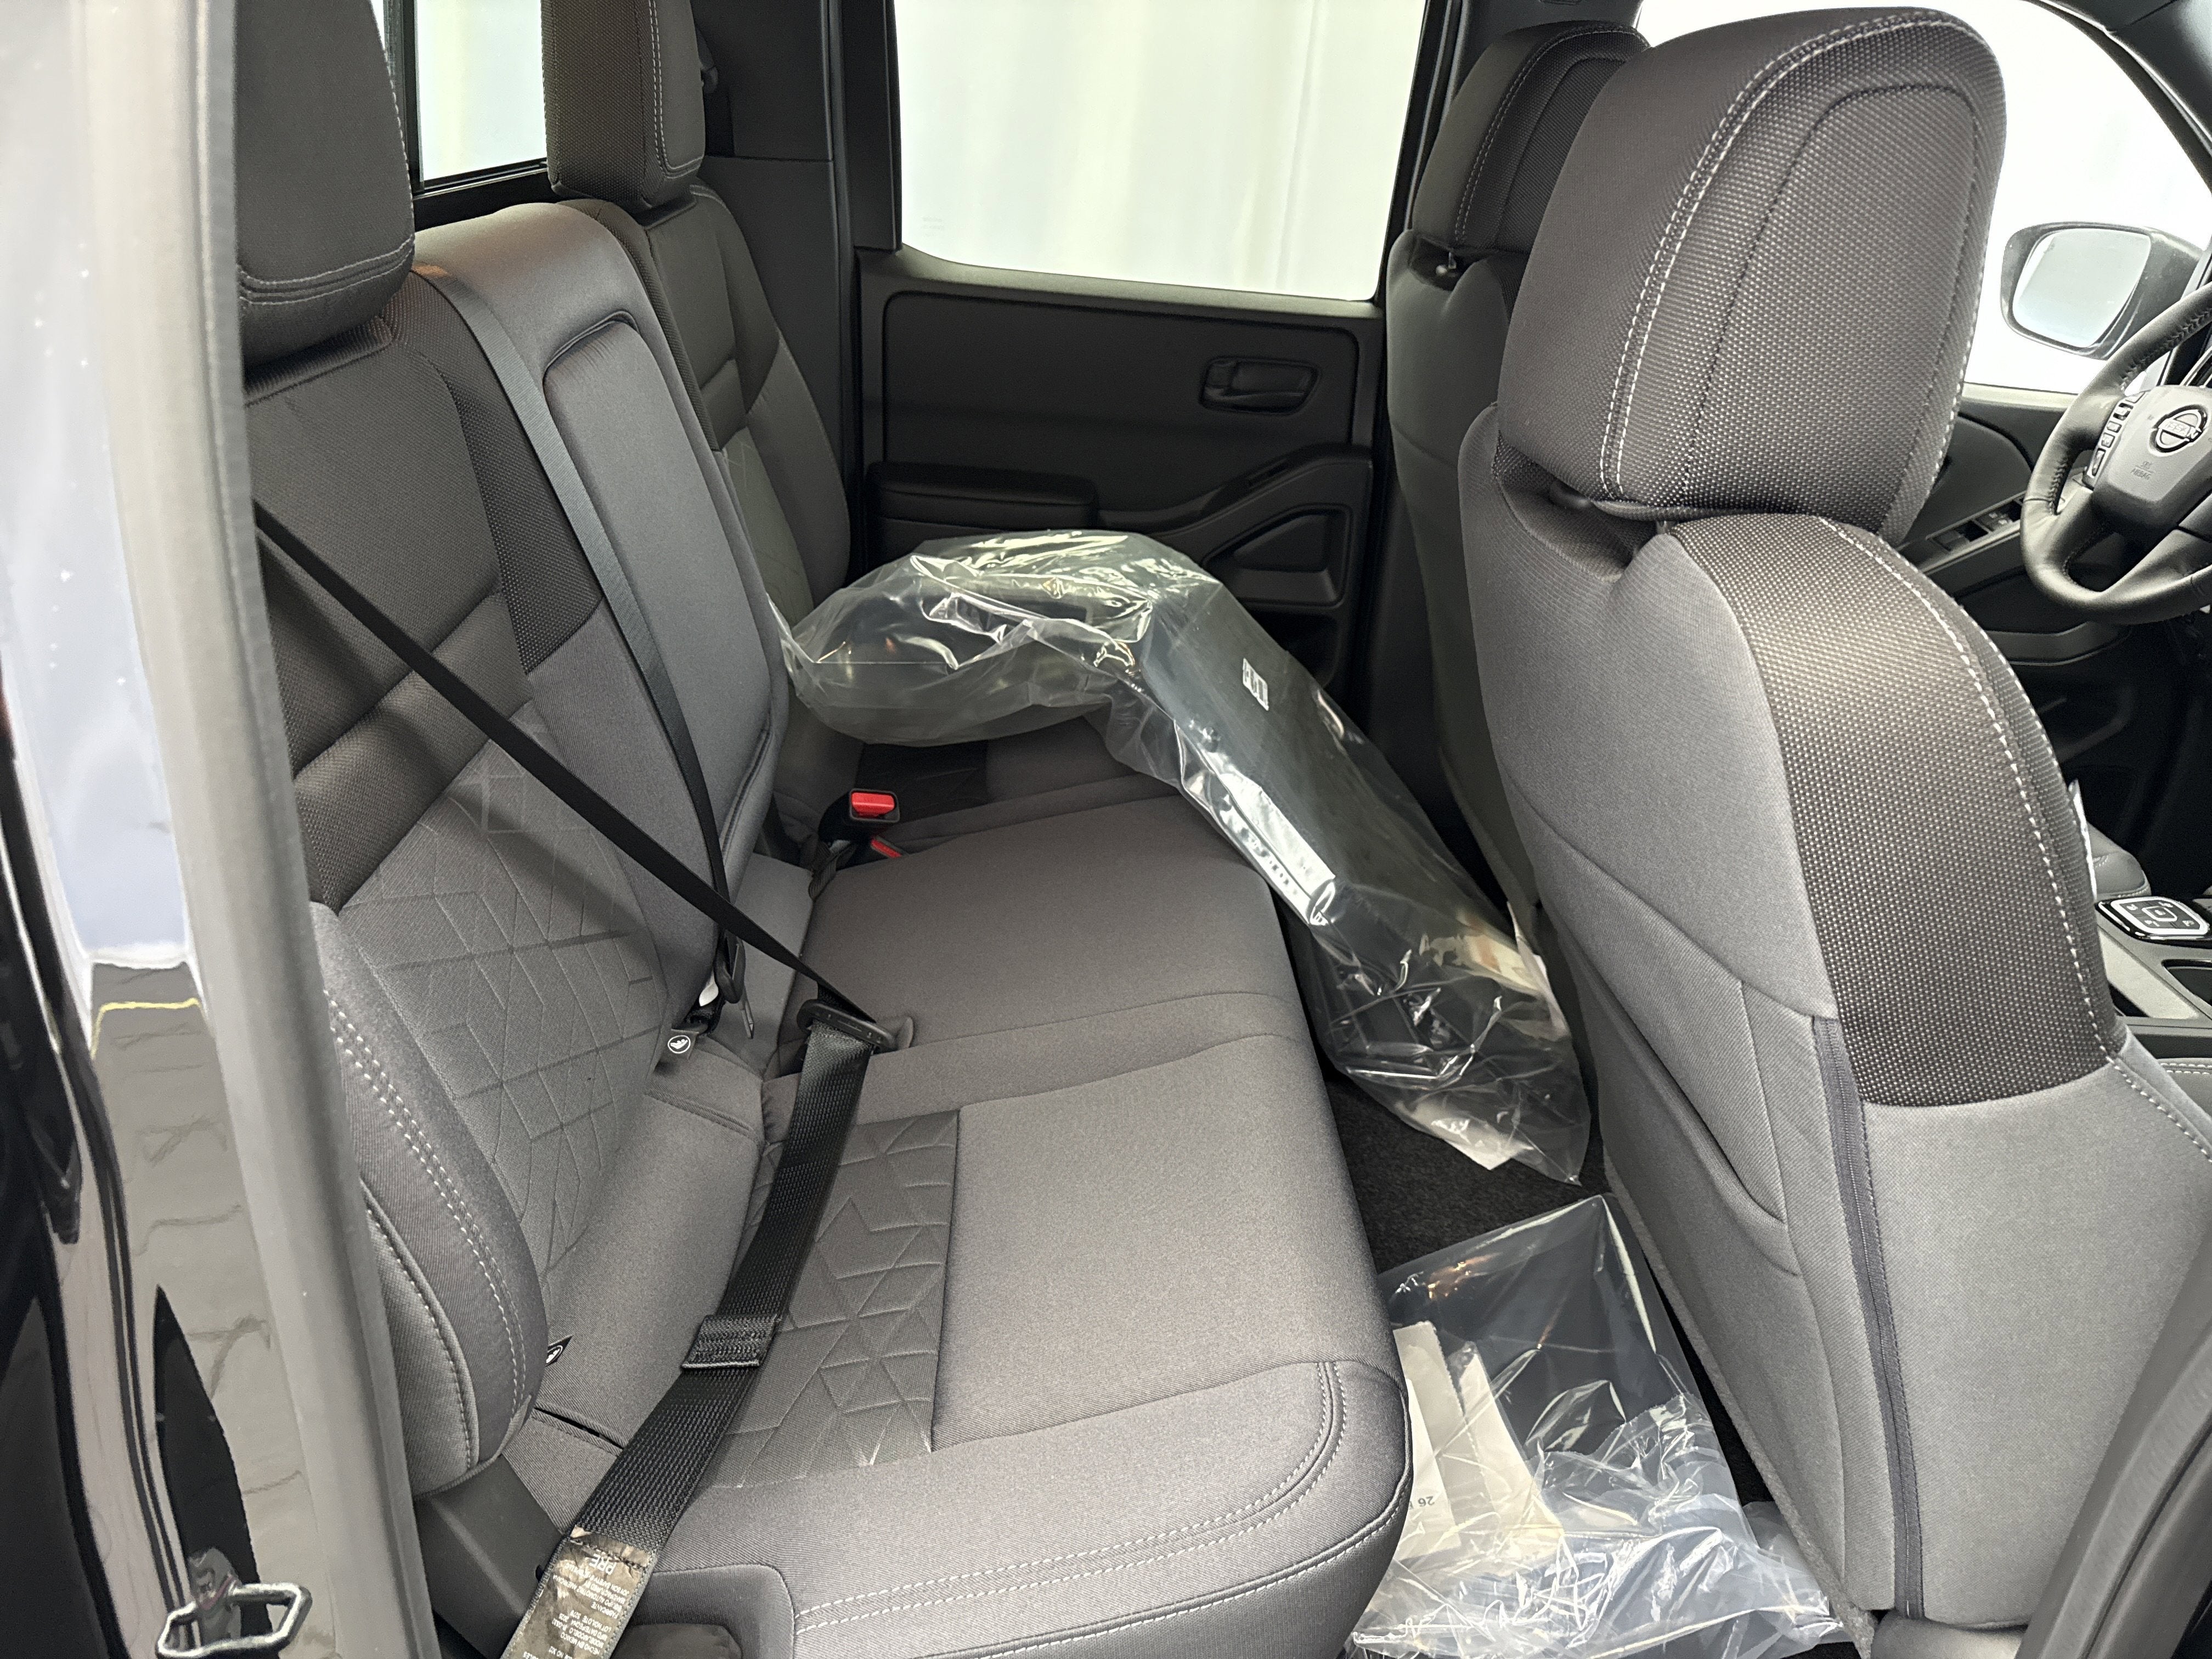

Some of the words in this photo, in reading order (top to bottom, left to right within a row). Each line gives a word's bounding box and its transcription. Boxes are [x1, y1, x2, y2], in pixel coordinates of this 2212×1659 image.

[1418, 1495, 1435, 1507] 26
[590, 1583, 625, 1604] MANUFACTURED
[591, 1601, 618, 1618] FABRICANTE
[560, 1632, 577, 1644] MEXICO
